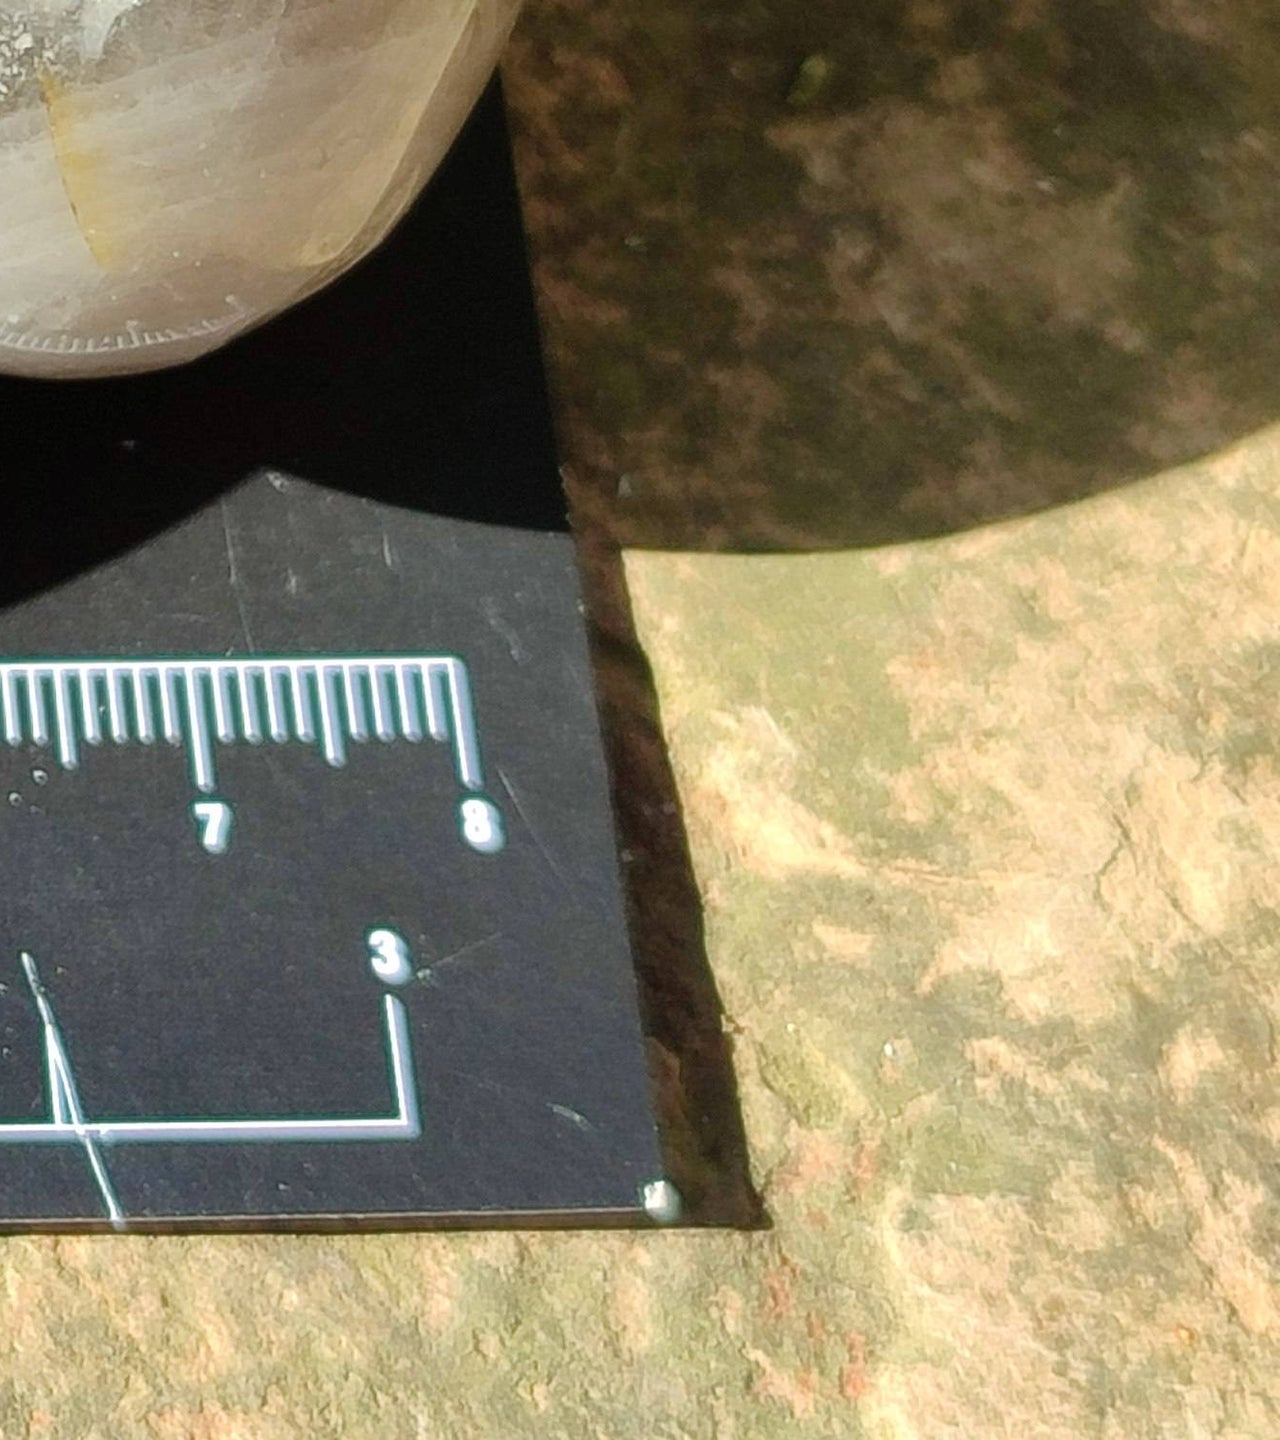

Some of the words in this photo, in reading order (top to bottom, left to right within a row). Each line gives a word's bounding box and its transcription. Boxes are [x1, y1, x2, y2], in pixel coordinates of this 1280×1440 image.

[193, 801, 231, 854] 7
[460, 798, 503, 852] 8
[367, 929, 411, 985] 3
